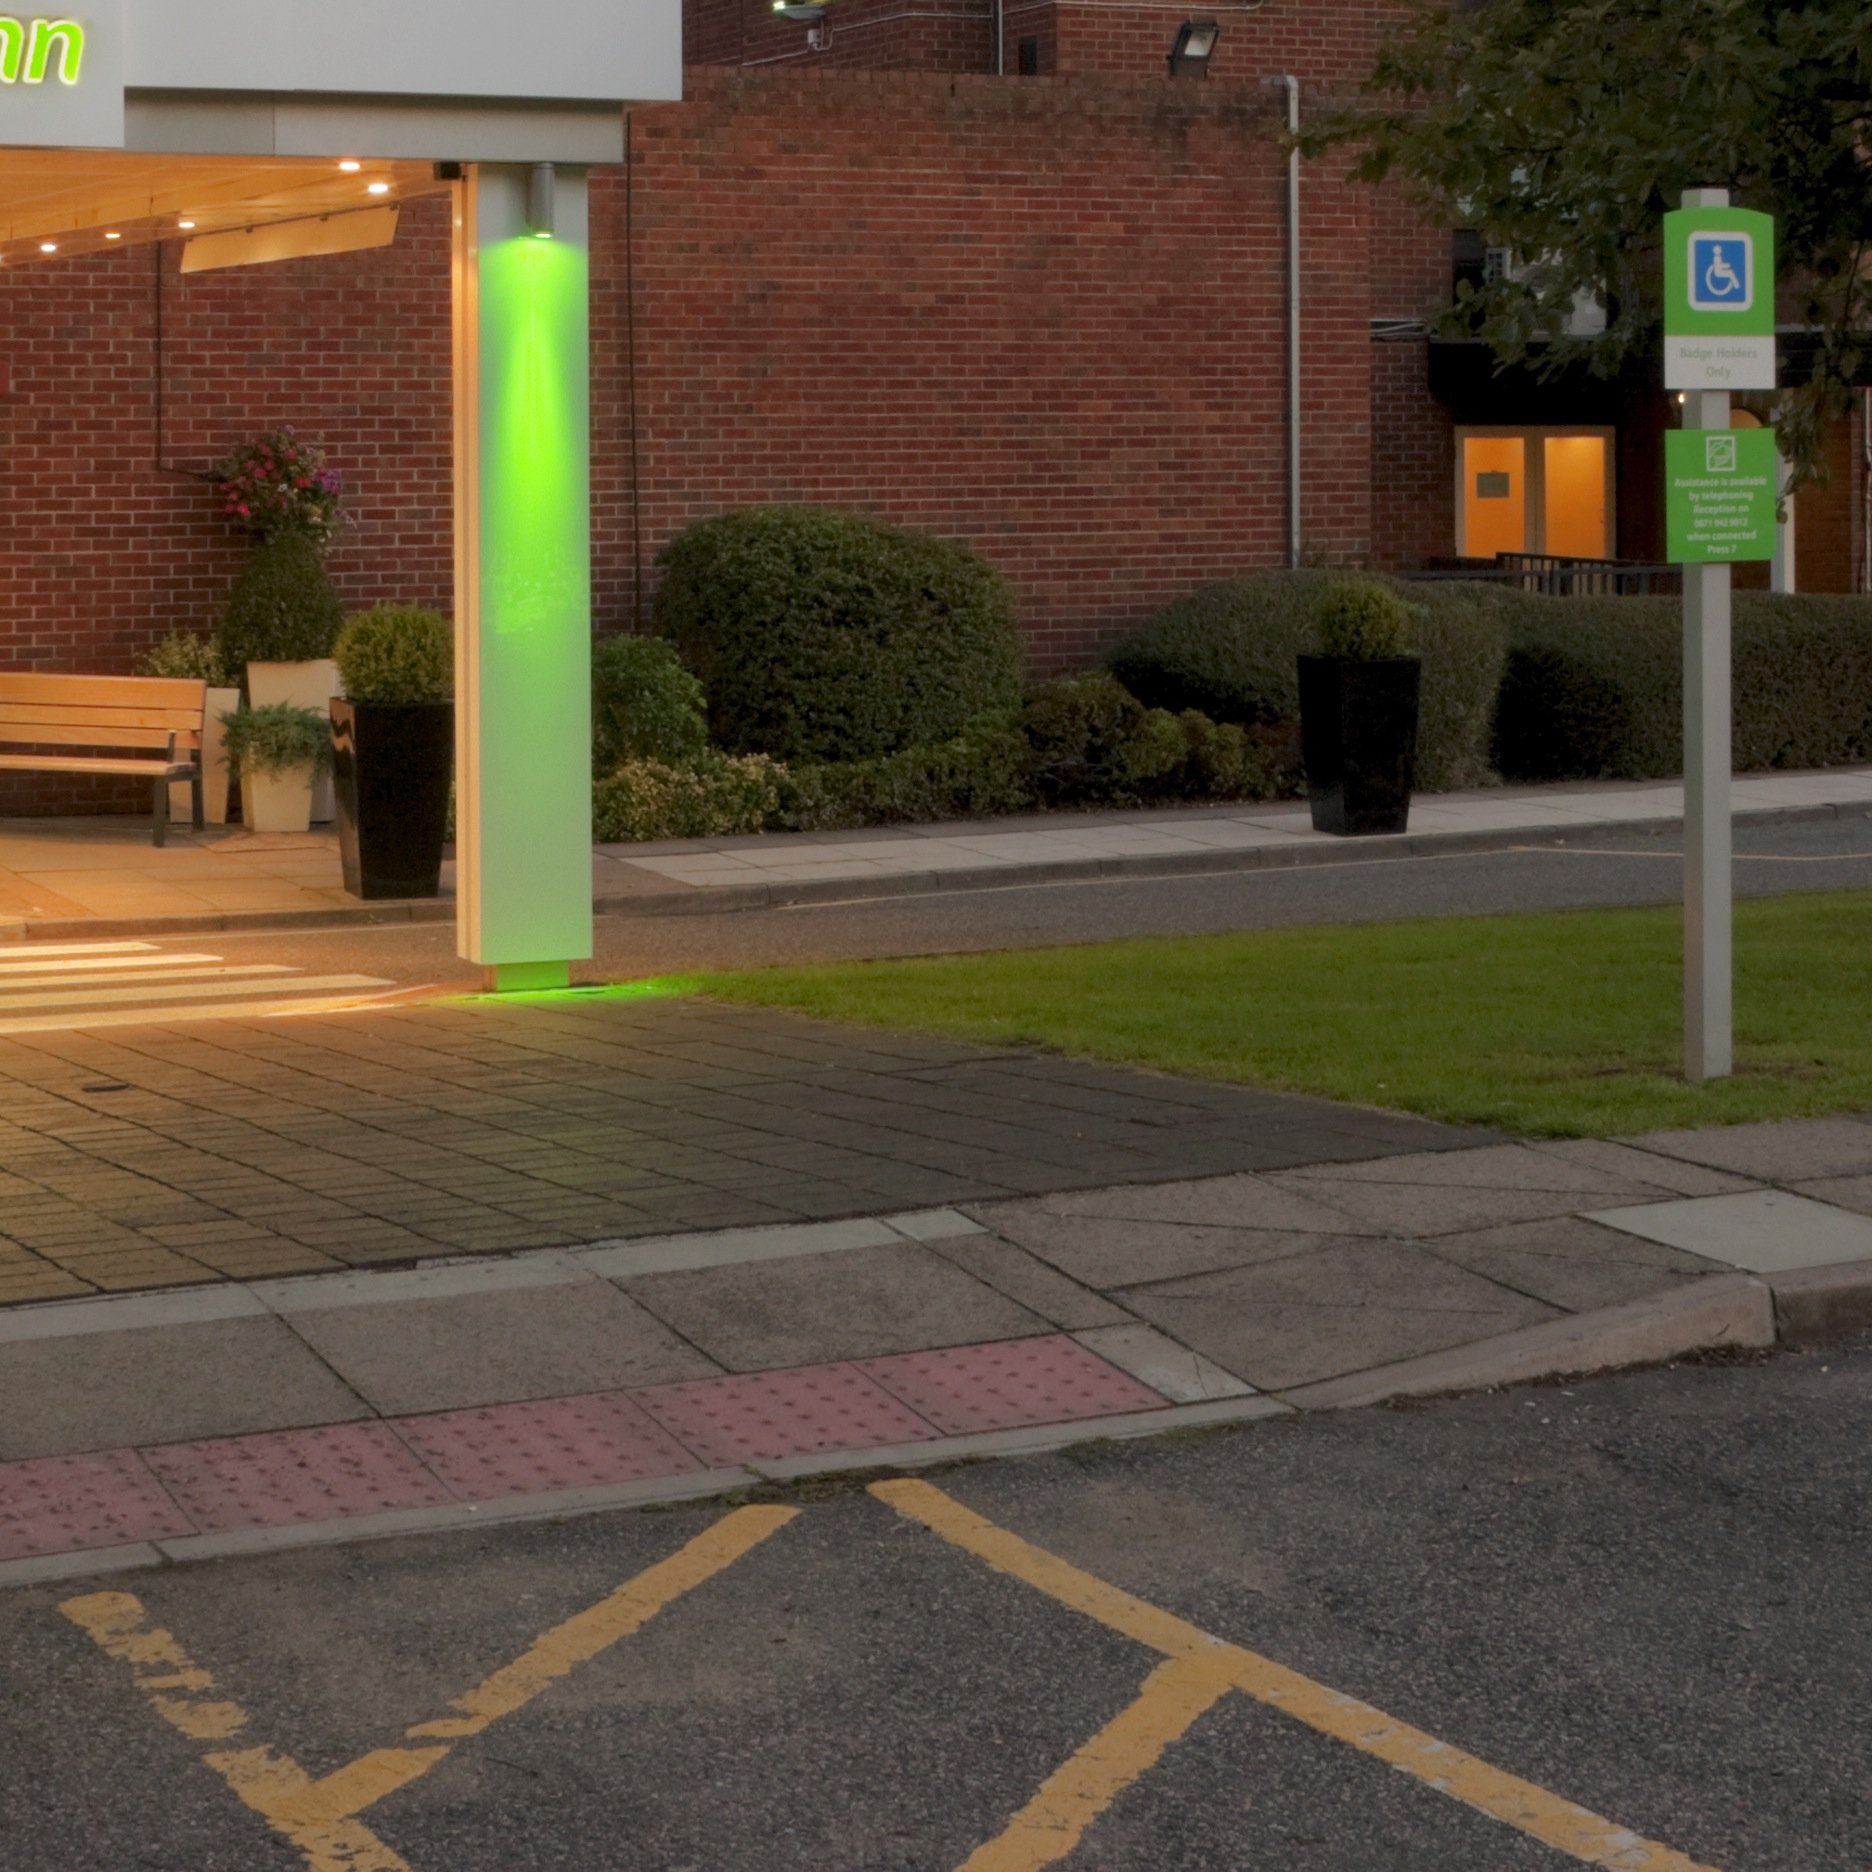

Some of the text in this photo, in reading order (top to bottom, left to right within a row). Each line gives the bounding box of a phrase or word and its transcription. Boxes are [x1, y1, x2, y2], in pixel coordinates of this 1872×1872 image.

[1679, 346, 1758, 361] Badge Holders
[1706, 365, 1731, 379] Only
[1674, 475, 1767, 488] Assistance is available
[1689, 490, 1754, 502] by telephoning
[1693, 504, 1750, 515] Reception on
[1686, 529, 1758, 541] when connected
[1707, 544, 1729, 554] Press
